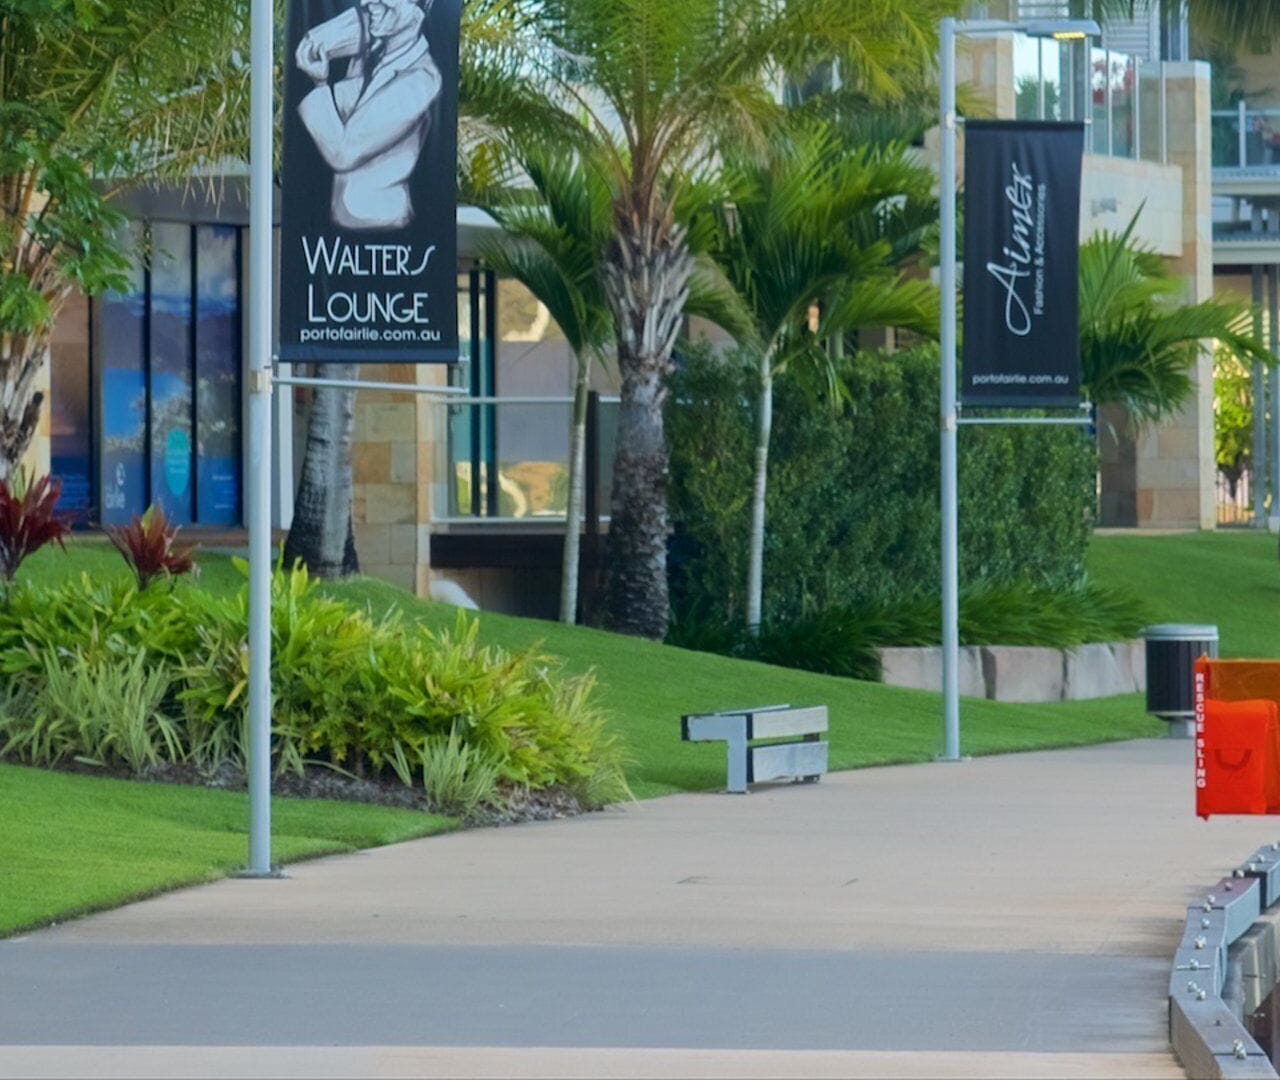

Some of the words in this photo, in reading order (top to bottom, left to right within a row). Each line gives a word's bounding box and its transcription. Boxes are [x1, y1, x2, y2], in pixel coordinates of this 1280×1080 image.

[1033, 257, 1045, 267] &
[308, 283, 429, 324] LOUNGE
[1033, 268, 1046, 315] Fashion
[300, 326, 441, 343] portofairlie.com.au
[1195, 672, 1205, 733] RESCUE
[1196, 738, 1207, 789] SLING
